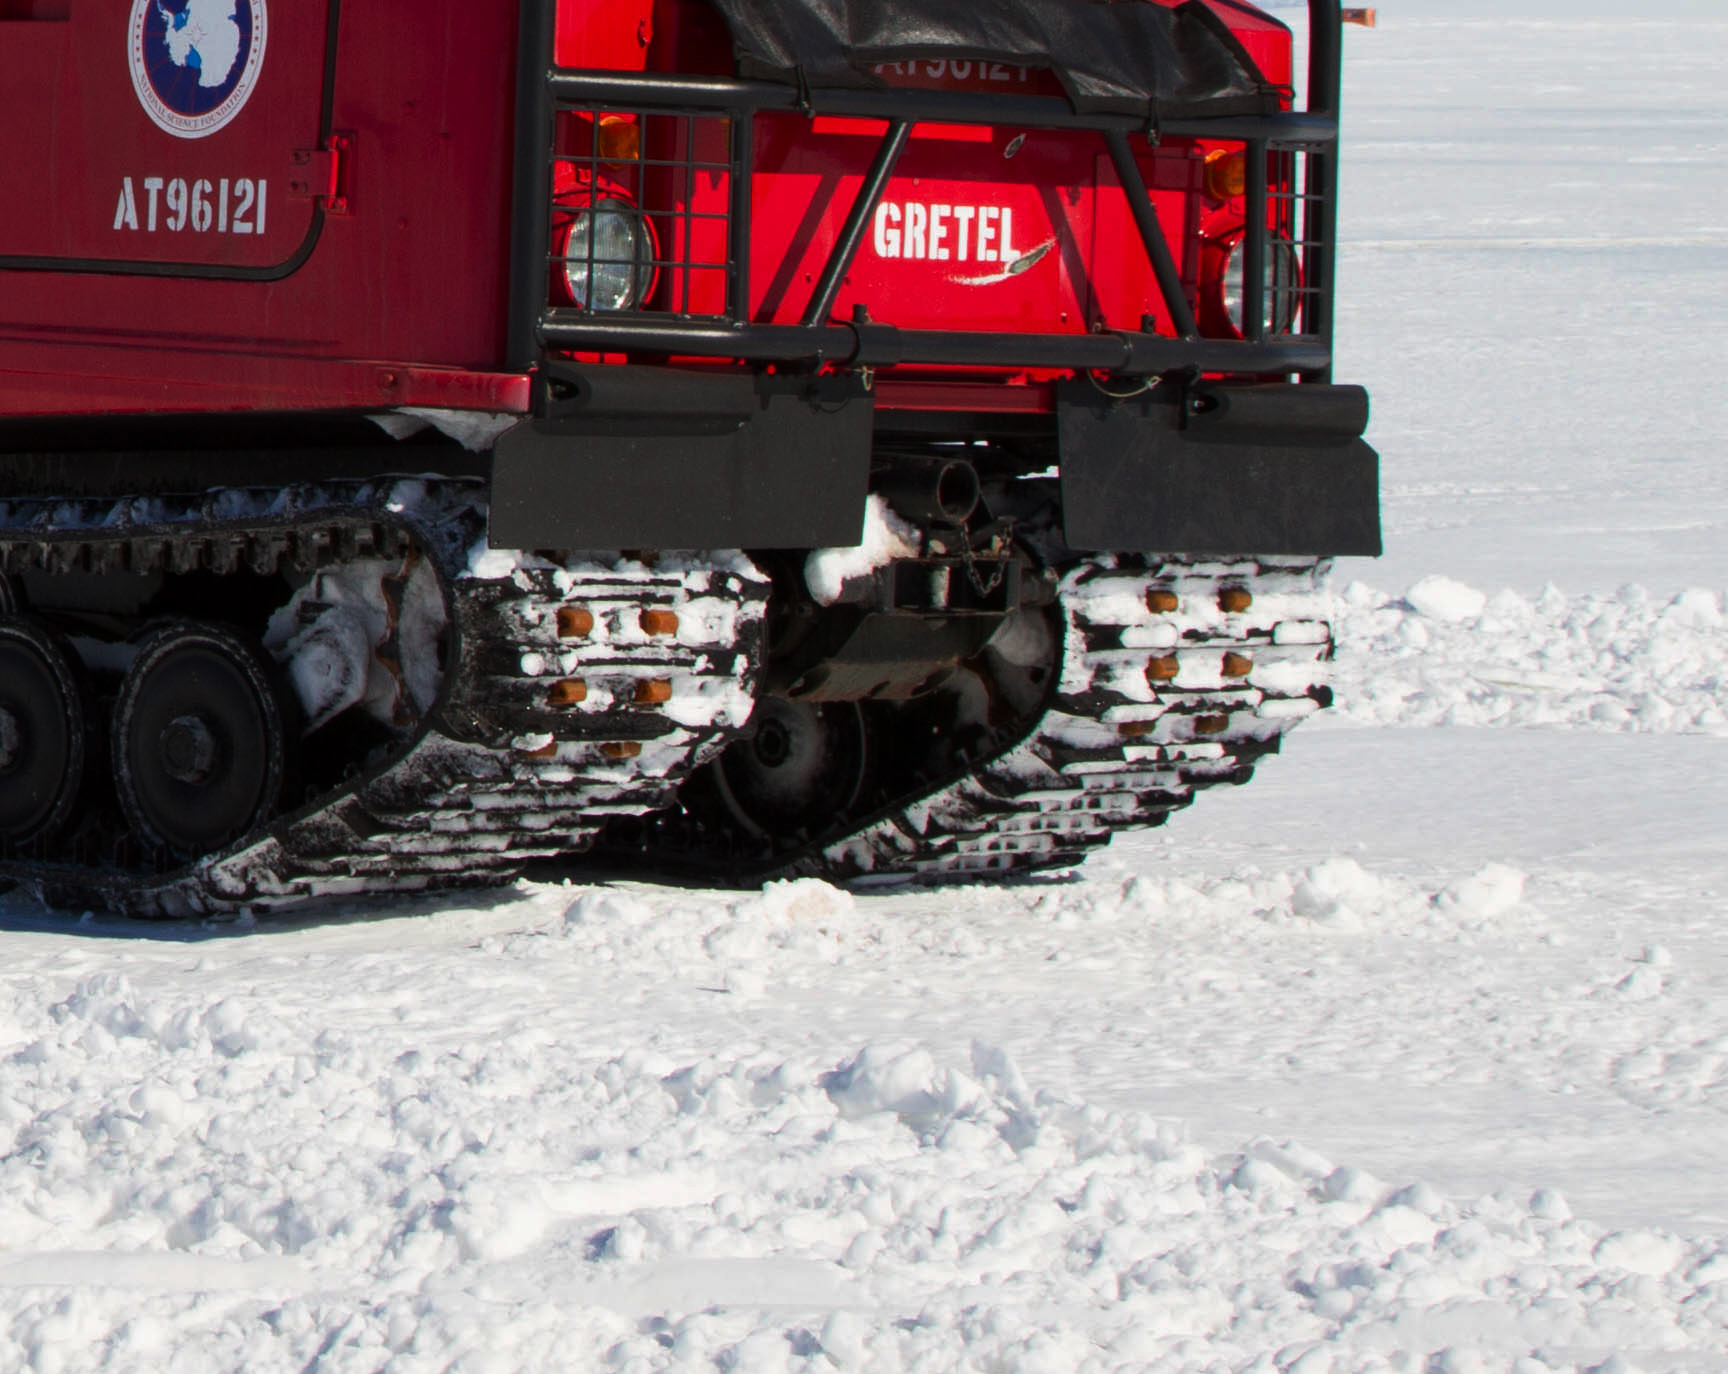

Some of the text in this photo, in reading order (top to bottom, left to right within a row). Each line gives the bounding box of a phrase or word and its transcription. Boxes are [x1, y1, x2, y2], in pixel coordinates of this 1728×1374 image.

[141, 74, 245, 128] NATIONAL SCIENCE FOUNDATION
[113, 177, 267, 234] AT96121
[874, 202, 1021, 262] GRETEL
